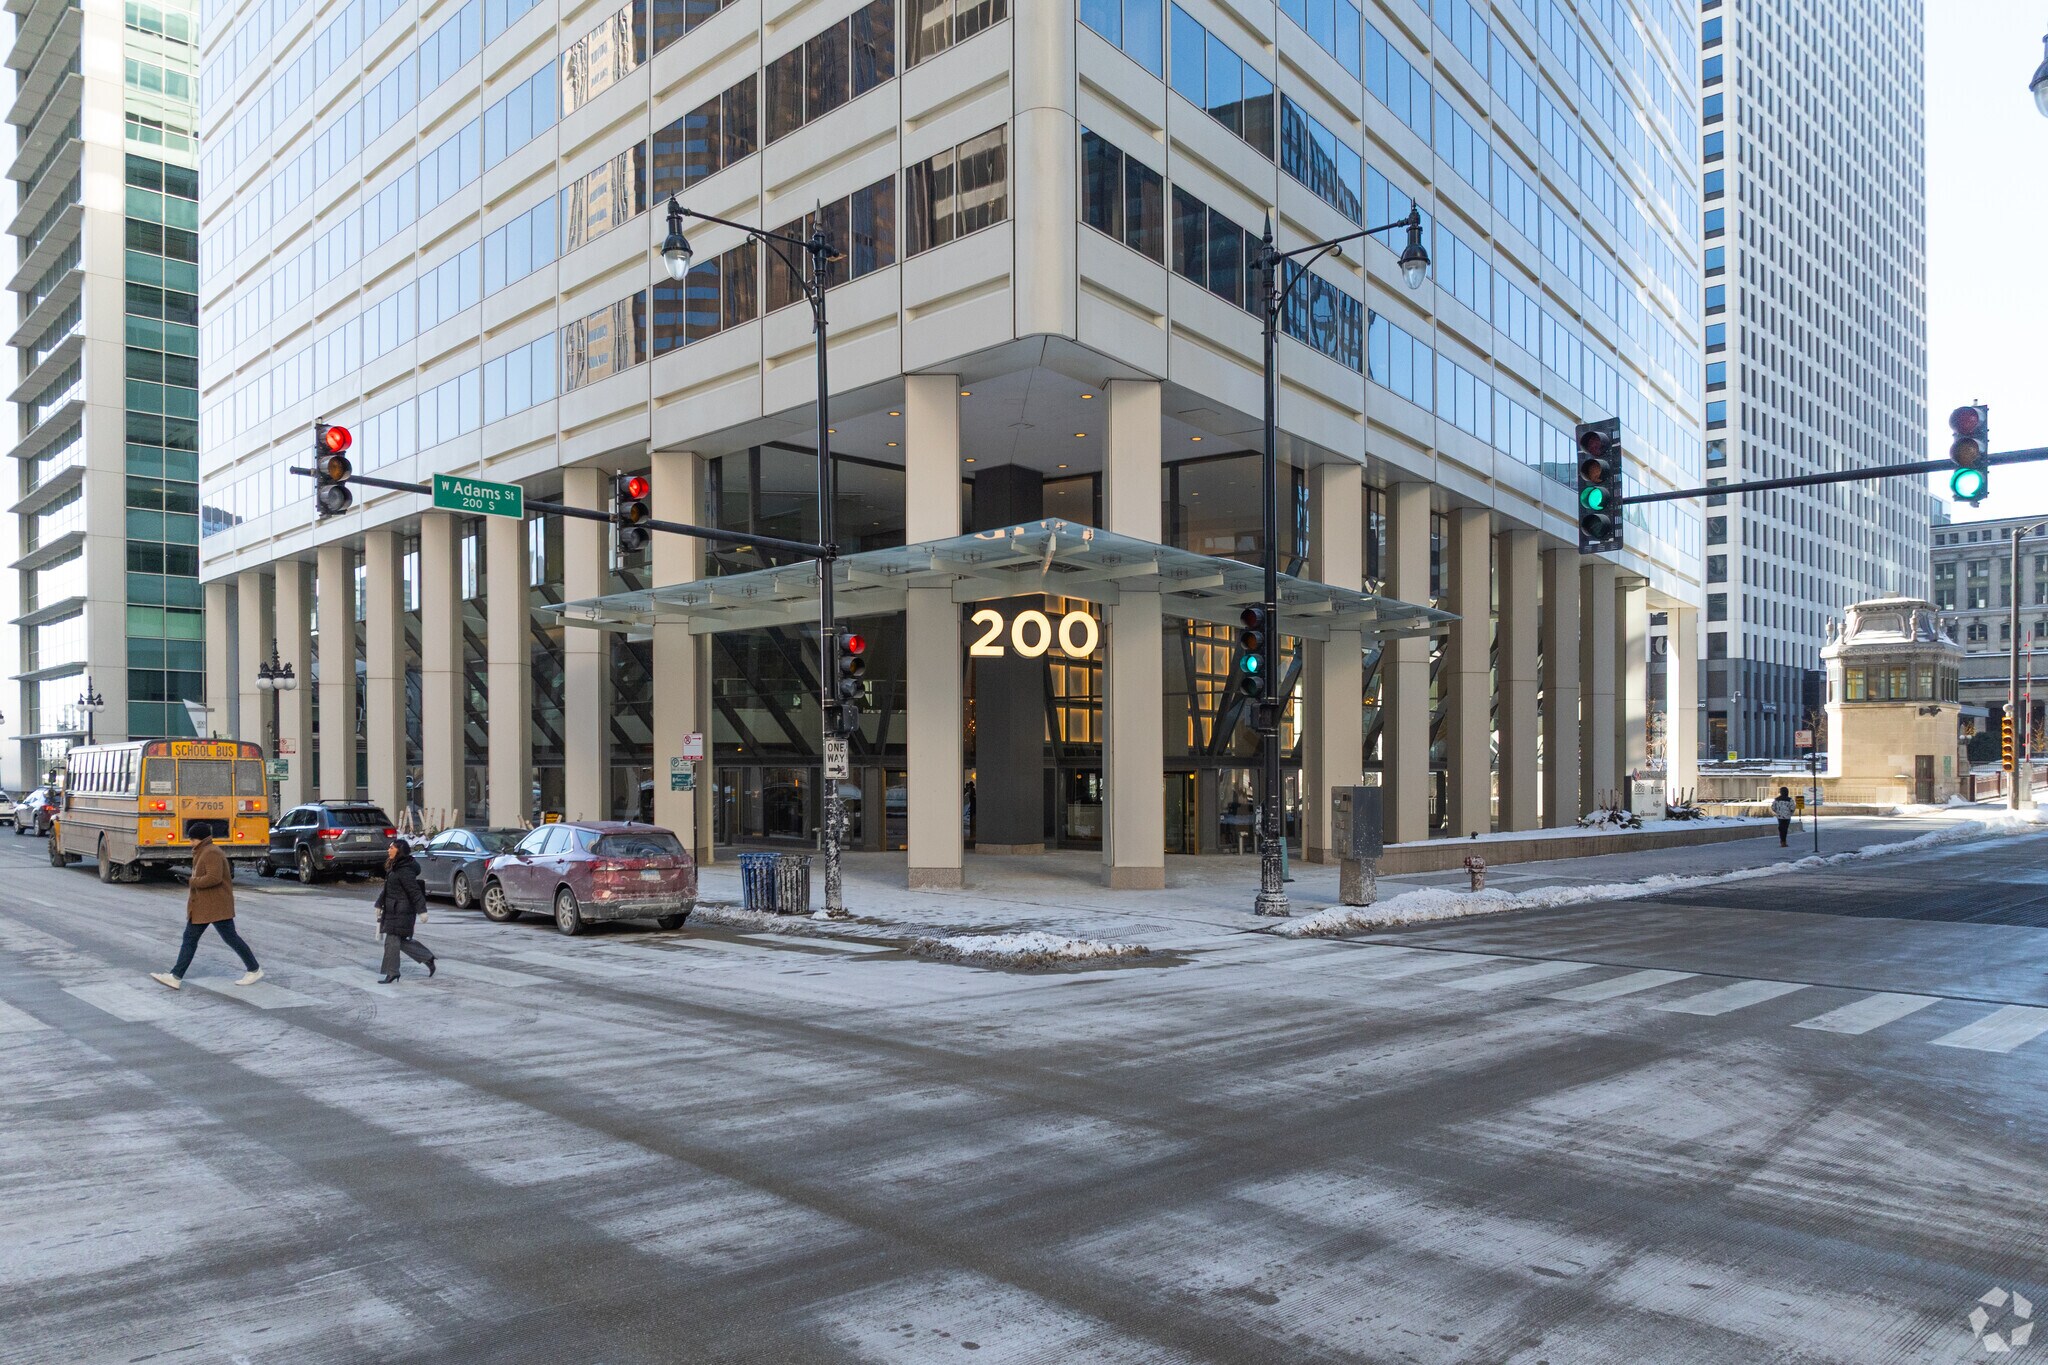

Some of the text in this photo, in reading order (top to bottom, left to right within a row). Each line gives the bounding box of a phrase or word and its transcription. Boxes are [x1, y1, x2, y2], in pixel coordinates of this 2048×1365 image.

[441, 481, 515, 501] W Adams St
[462, 497, 495, 511] 200 S
[970, 609, 1099, 659] 200
[175, 745, 234, 757] SCHOOL BUS
[827, 743, 844, 752] ONE
[827, 754, 845, 763] WAY
[195, 801, 224, 810] 17605
